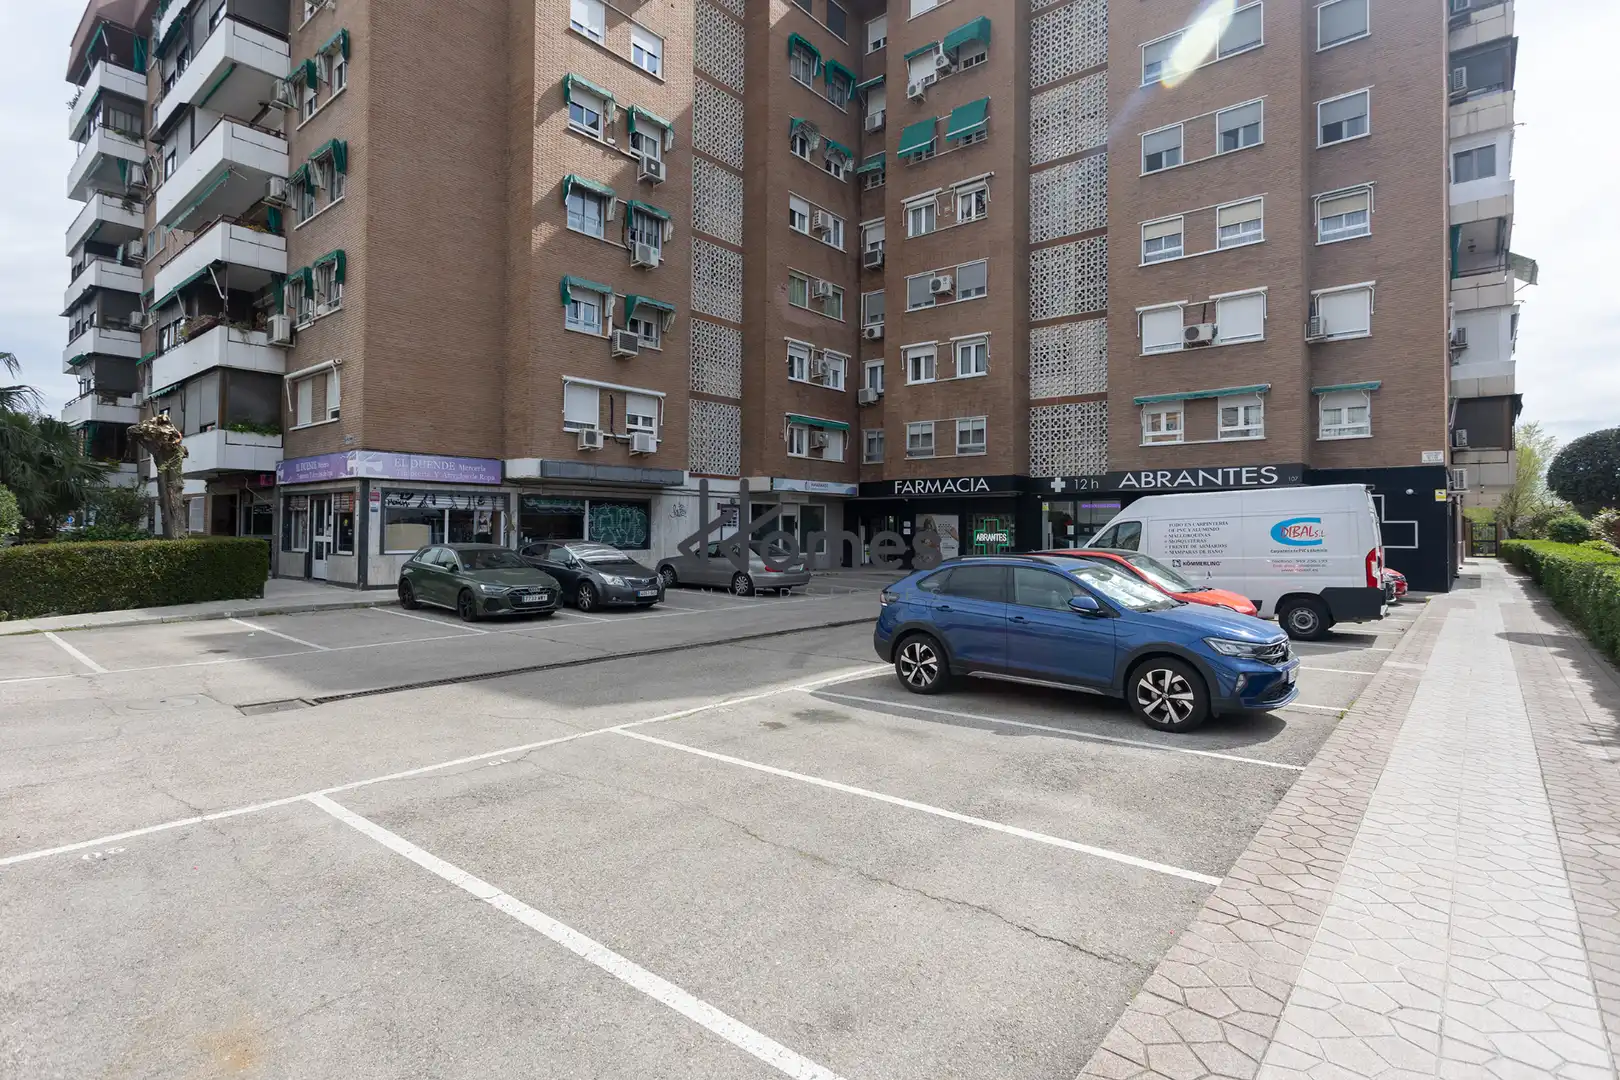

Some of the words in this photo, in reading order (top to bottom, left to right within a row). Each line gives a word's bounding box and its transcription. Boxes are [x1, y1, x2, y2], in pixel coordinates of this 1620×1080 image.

[394, 458, 408, 468] EL
[410, 459, 456, 471] DUENDE
[1074, 478, 1087, 490] 12
[1118, 466, 1279, 489] ABRANTES
[894, 477, 991, 495] FARMACIA
[976, 533, 1007, 542] ABRANTES
